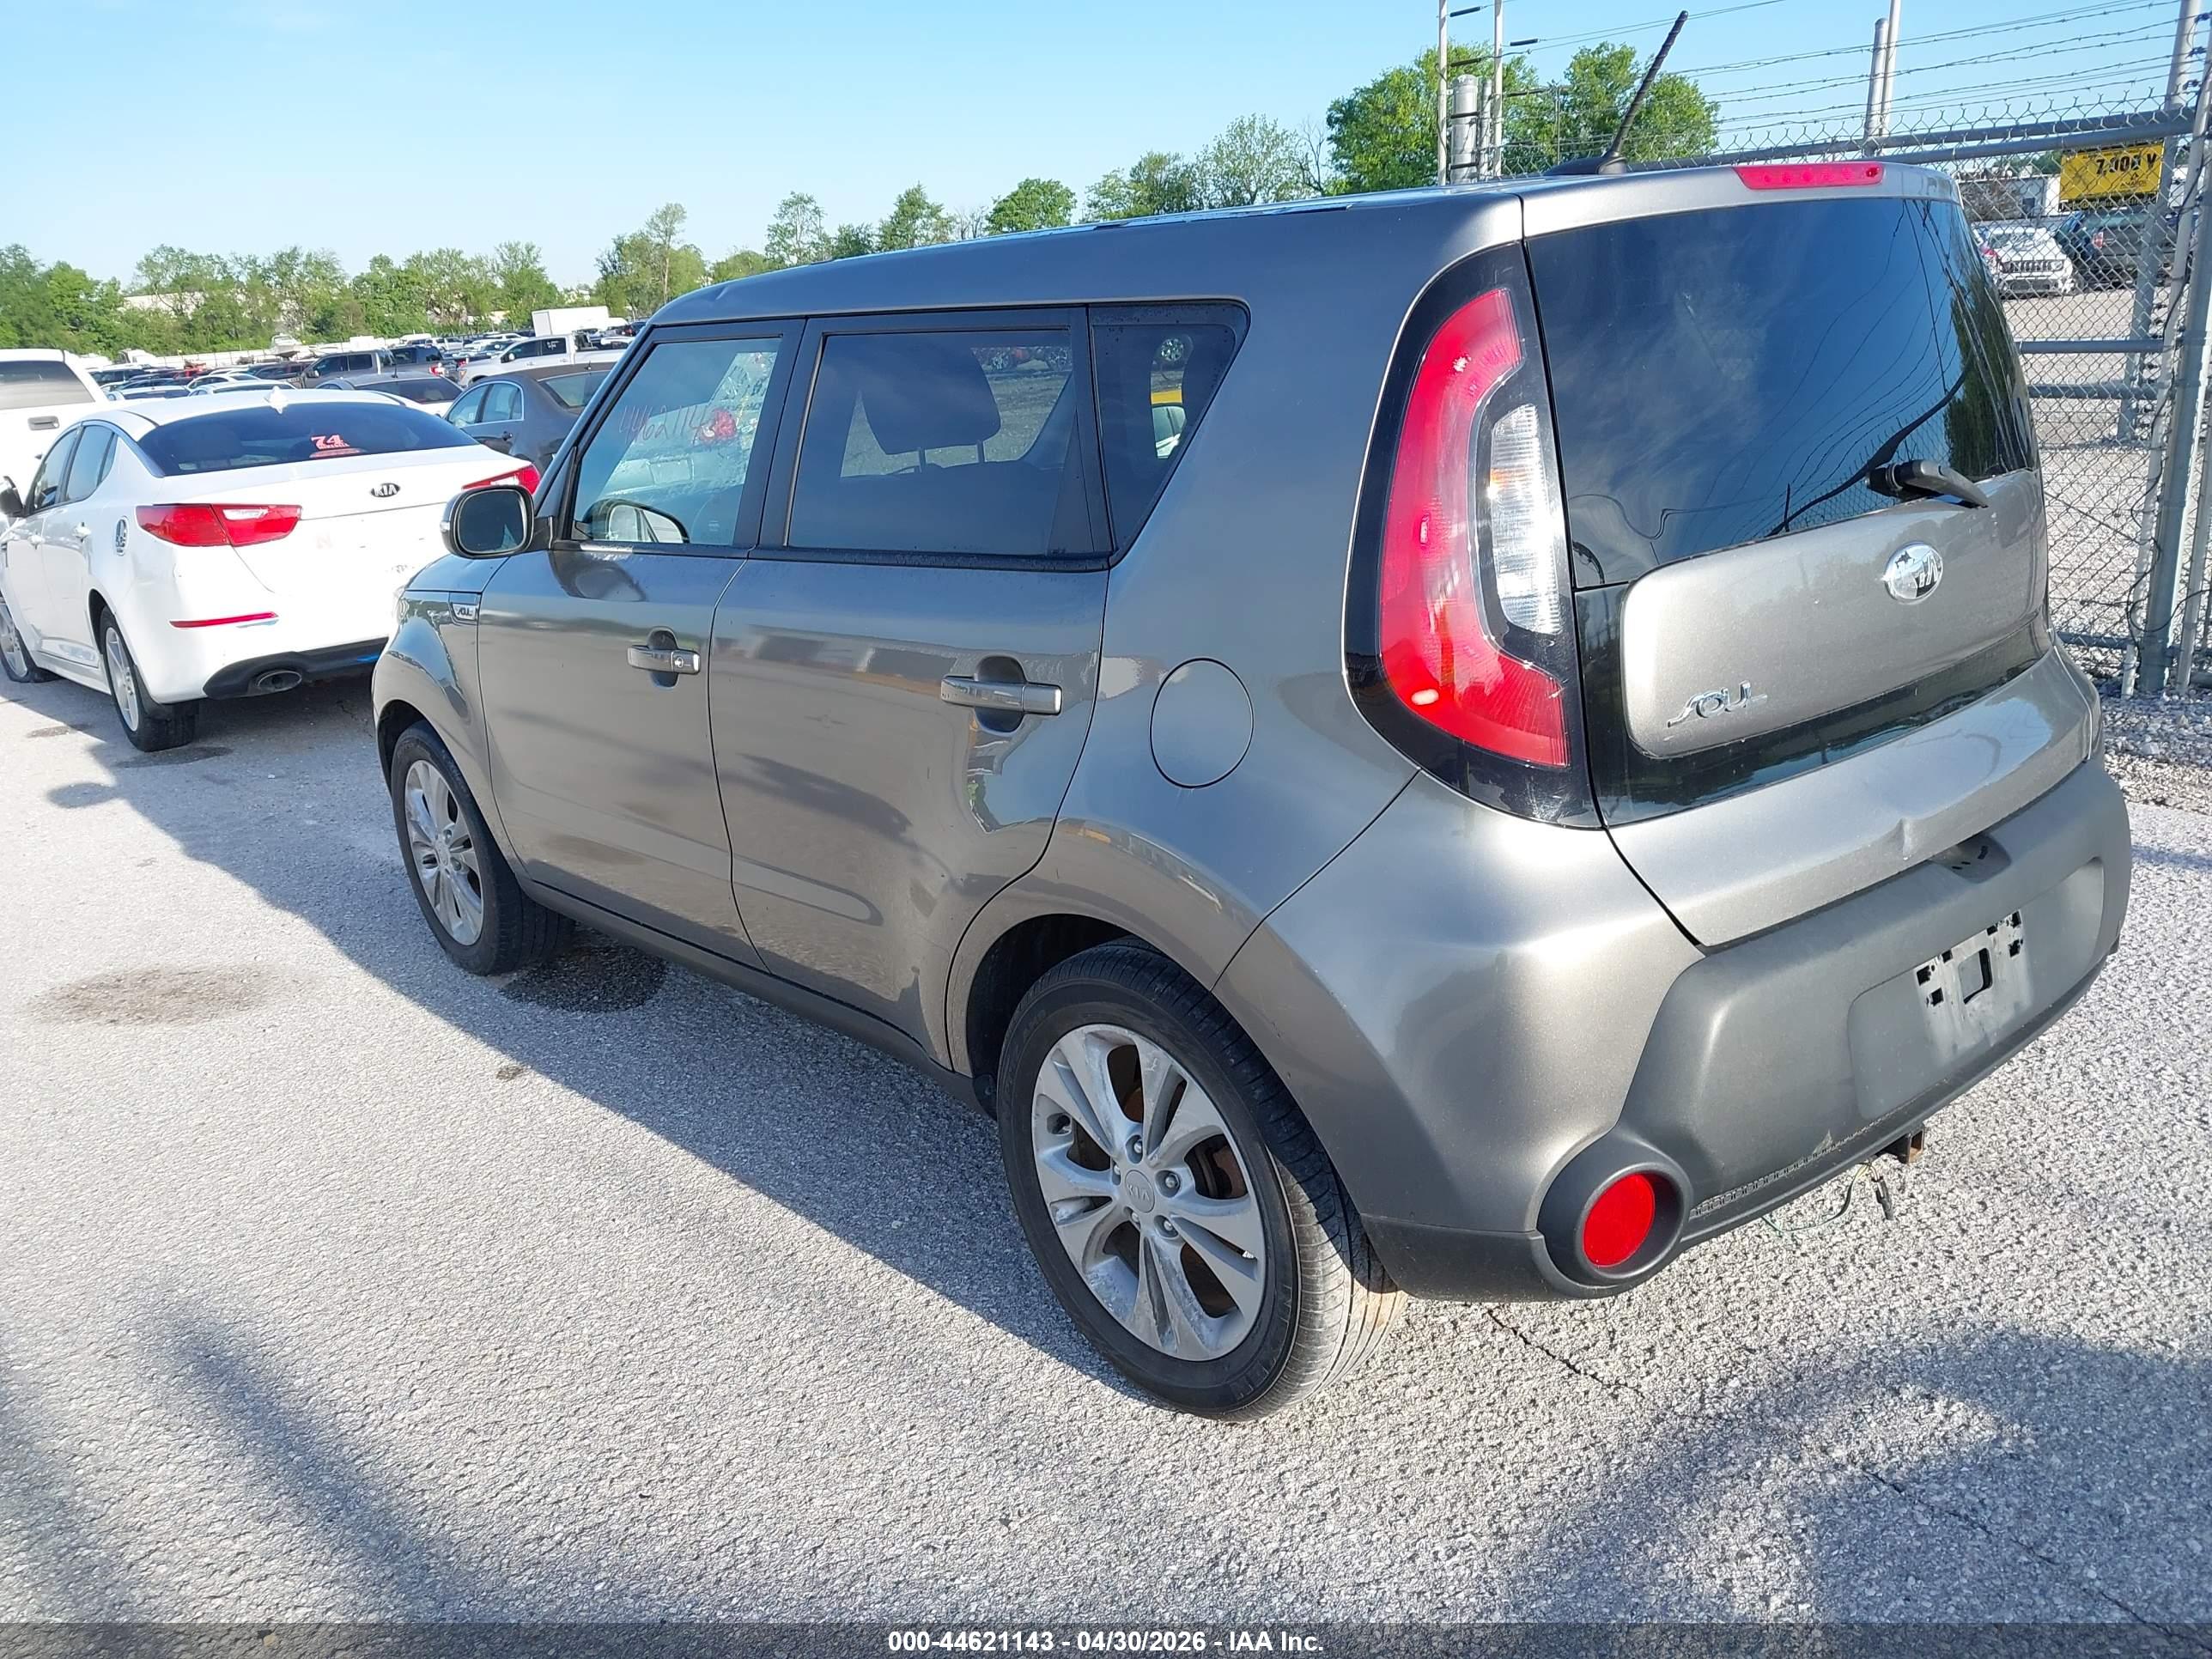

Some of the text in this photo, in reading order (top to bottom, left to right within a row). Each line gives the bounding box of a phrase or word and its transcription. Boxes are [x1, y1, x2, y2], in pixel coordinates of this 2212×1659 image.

[311, 434, 345, 450] 74
[373, 483, 399, 497] KIA
[1667, 680, 1768, 728] SOUL
[1127, 1182, 1150, 1201] KIA
